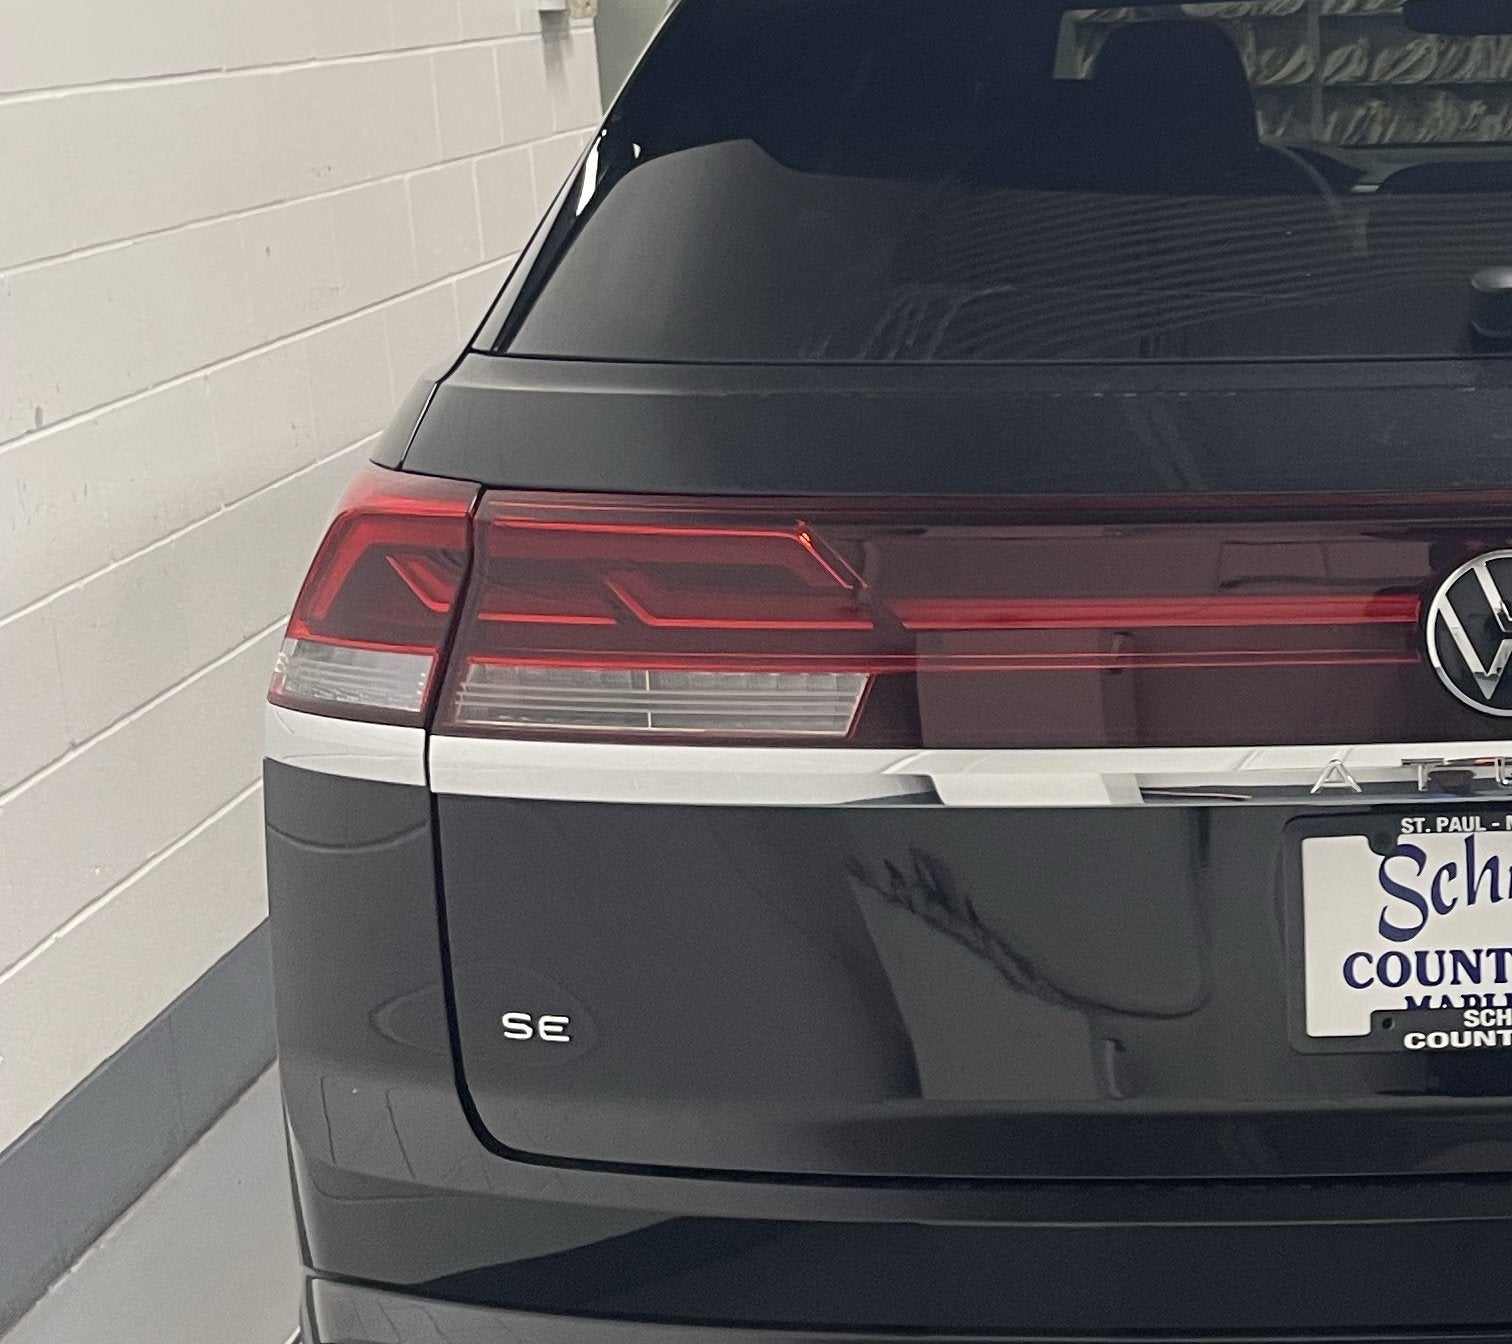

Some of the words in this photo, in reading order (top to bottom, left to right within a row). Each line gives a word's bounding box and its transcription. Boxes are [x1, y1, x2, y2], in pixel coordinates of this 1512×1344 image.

[1400, 816, 1431, 834] ST.
[1436, 816, 1486, 833] PAUL
[501, 1011, 571, 1043] SE
